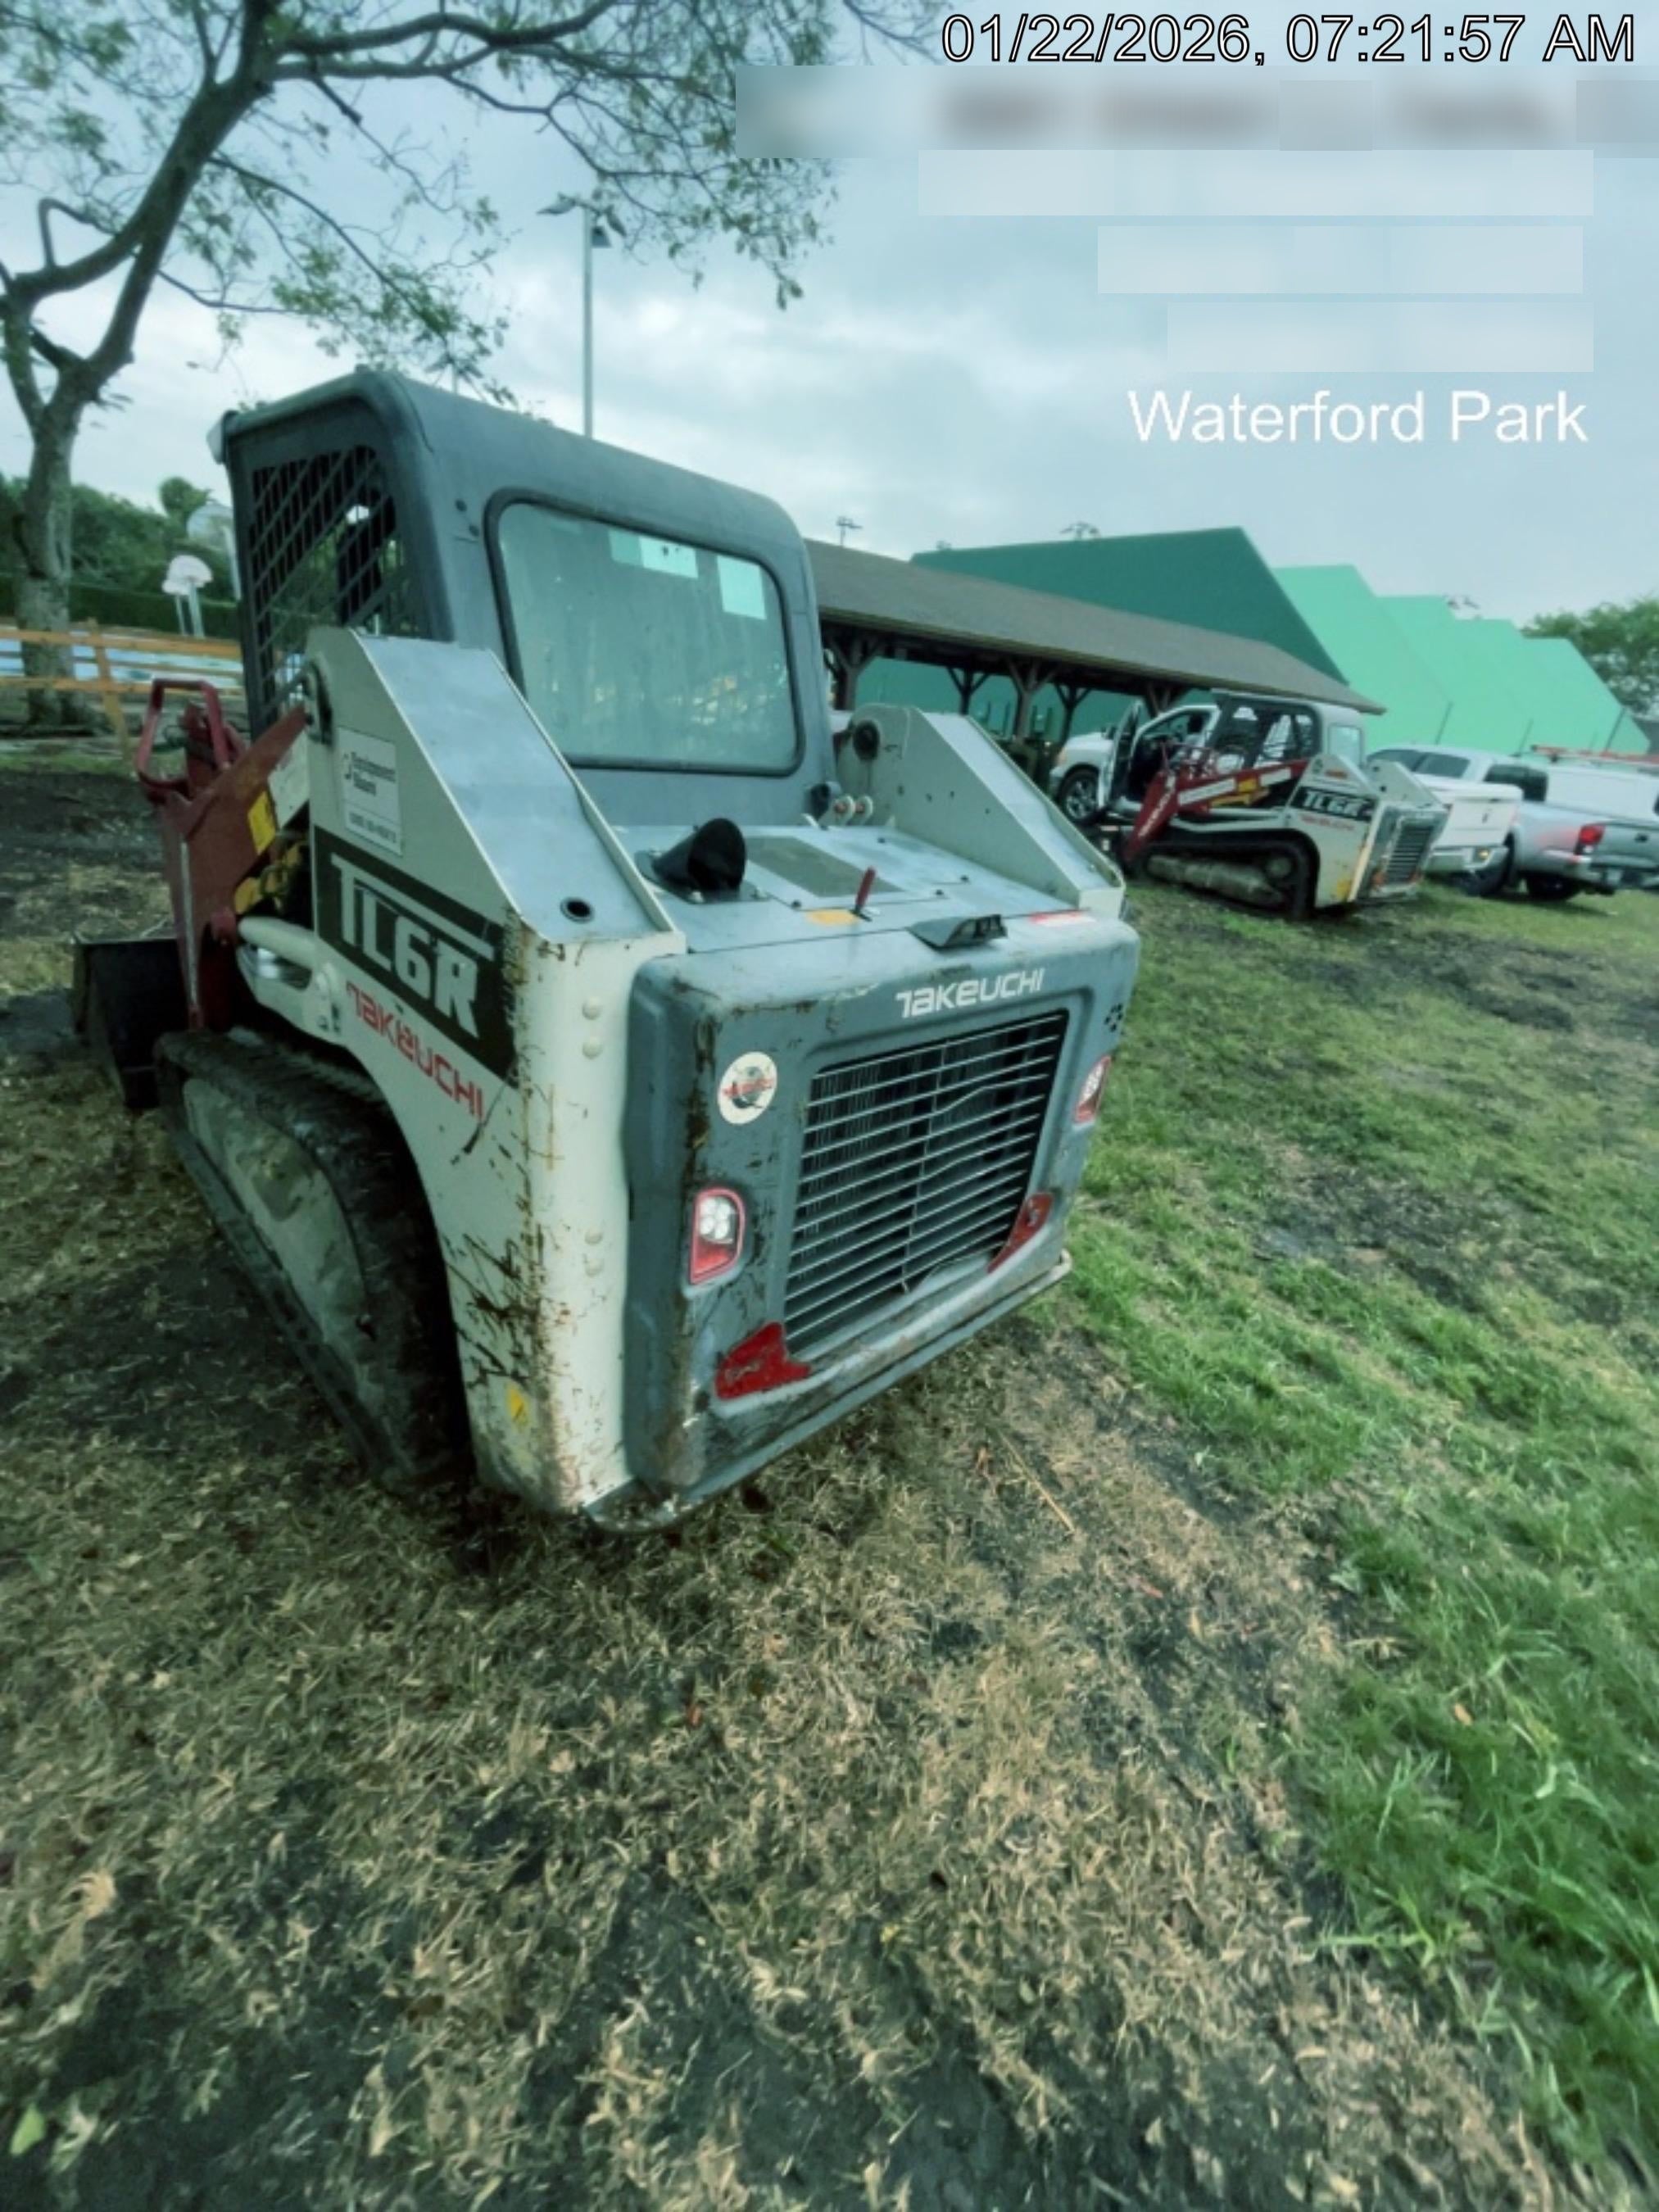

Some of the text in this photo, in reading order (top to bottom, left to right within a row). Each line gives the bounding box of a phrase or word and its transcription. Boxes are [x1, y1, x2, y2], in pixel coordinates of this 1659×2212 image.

[331, 853, 495, 1038] TL6R
[895, 968, 1045, 1018] TAKEUCHI
[347, 981, 483, 1123] TAKEUCHI
